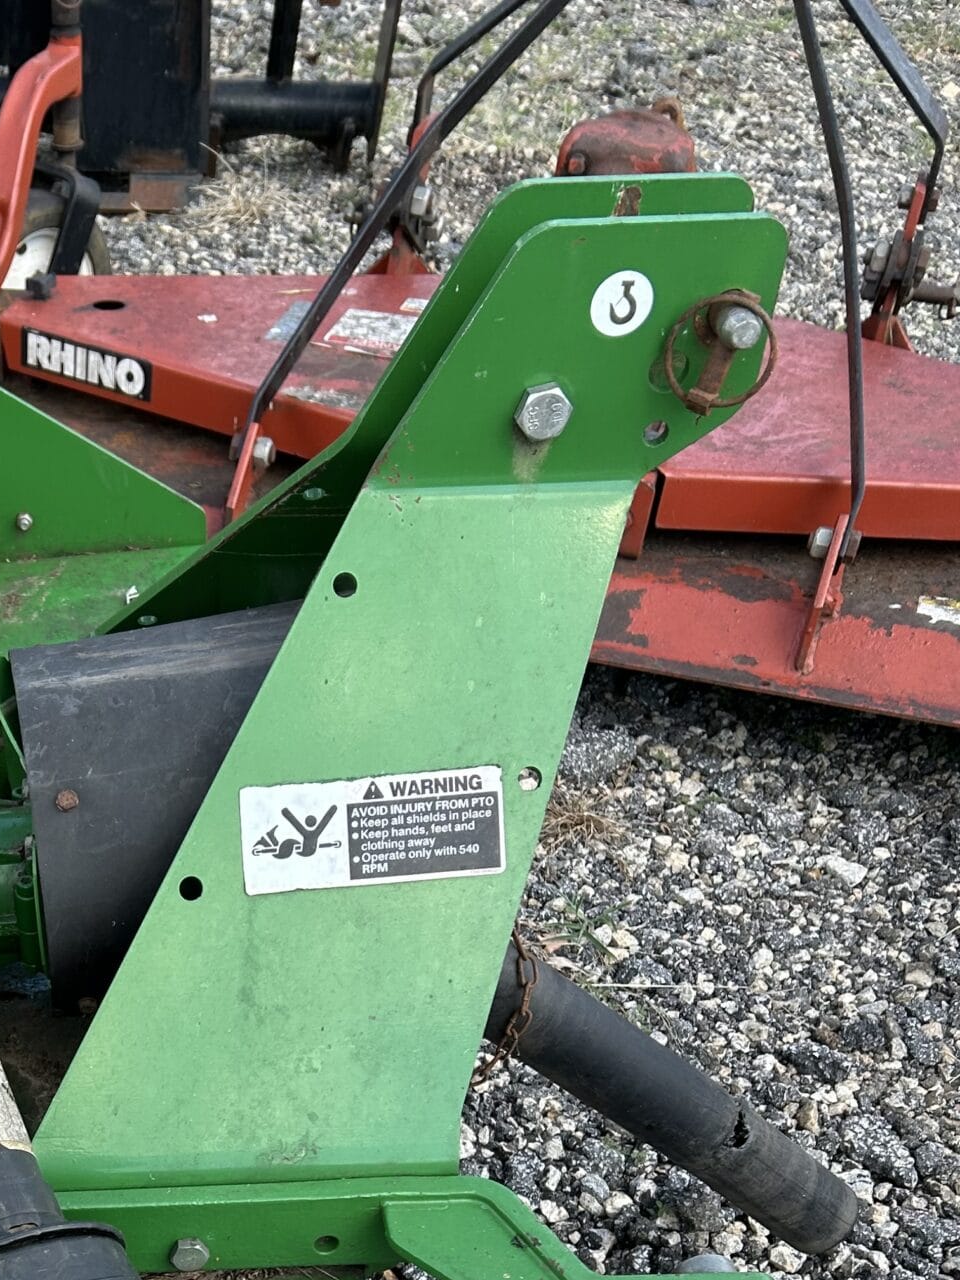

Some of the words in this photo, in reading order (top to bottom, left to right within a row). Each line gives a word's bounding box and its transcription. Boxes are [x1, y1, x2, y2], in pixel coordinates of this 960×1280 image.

[26, 332, 145, 396] RHINO
[389, 774, 482, 797] WARNING
[351, 805, 388, 818] AVOID
[390, 801, 433, 815] INJURY
[435, 798, 469, 810] FROM
[471, 796, 494, 807] PTO
[360, 818, 389, 828] Keep
[391, 815, 404, 825] all
[406, 812, 446, 824] shields
[449, 810, 459, 820] in
[461, 809, 492, 821] place
[360, 829, 389, 840] Keep
[391, 825, 429, 837] hands,
[430, 823, 452, 833] feet
[454, 820, 475, 831] and
[361, 839, 405, 851] clothing
[407, 837, 436, 848] away
[361, 851, 406, 863] Operate
[408, 848, 432, 859] only
[434, 845, 457, 856] with
[458, 844, 480, 855] 540
[362, 863, 389, 874] RPM
